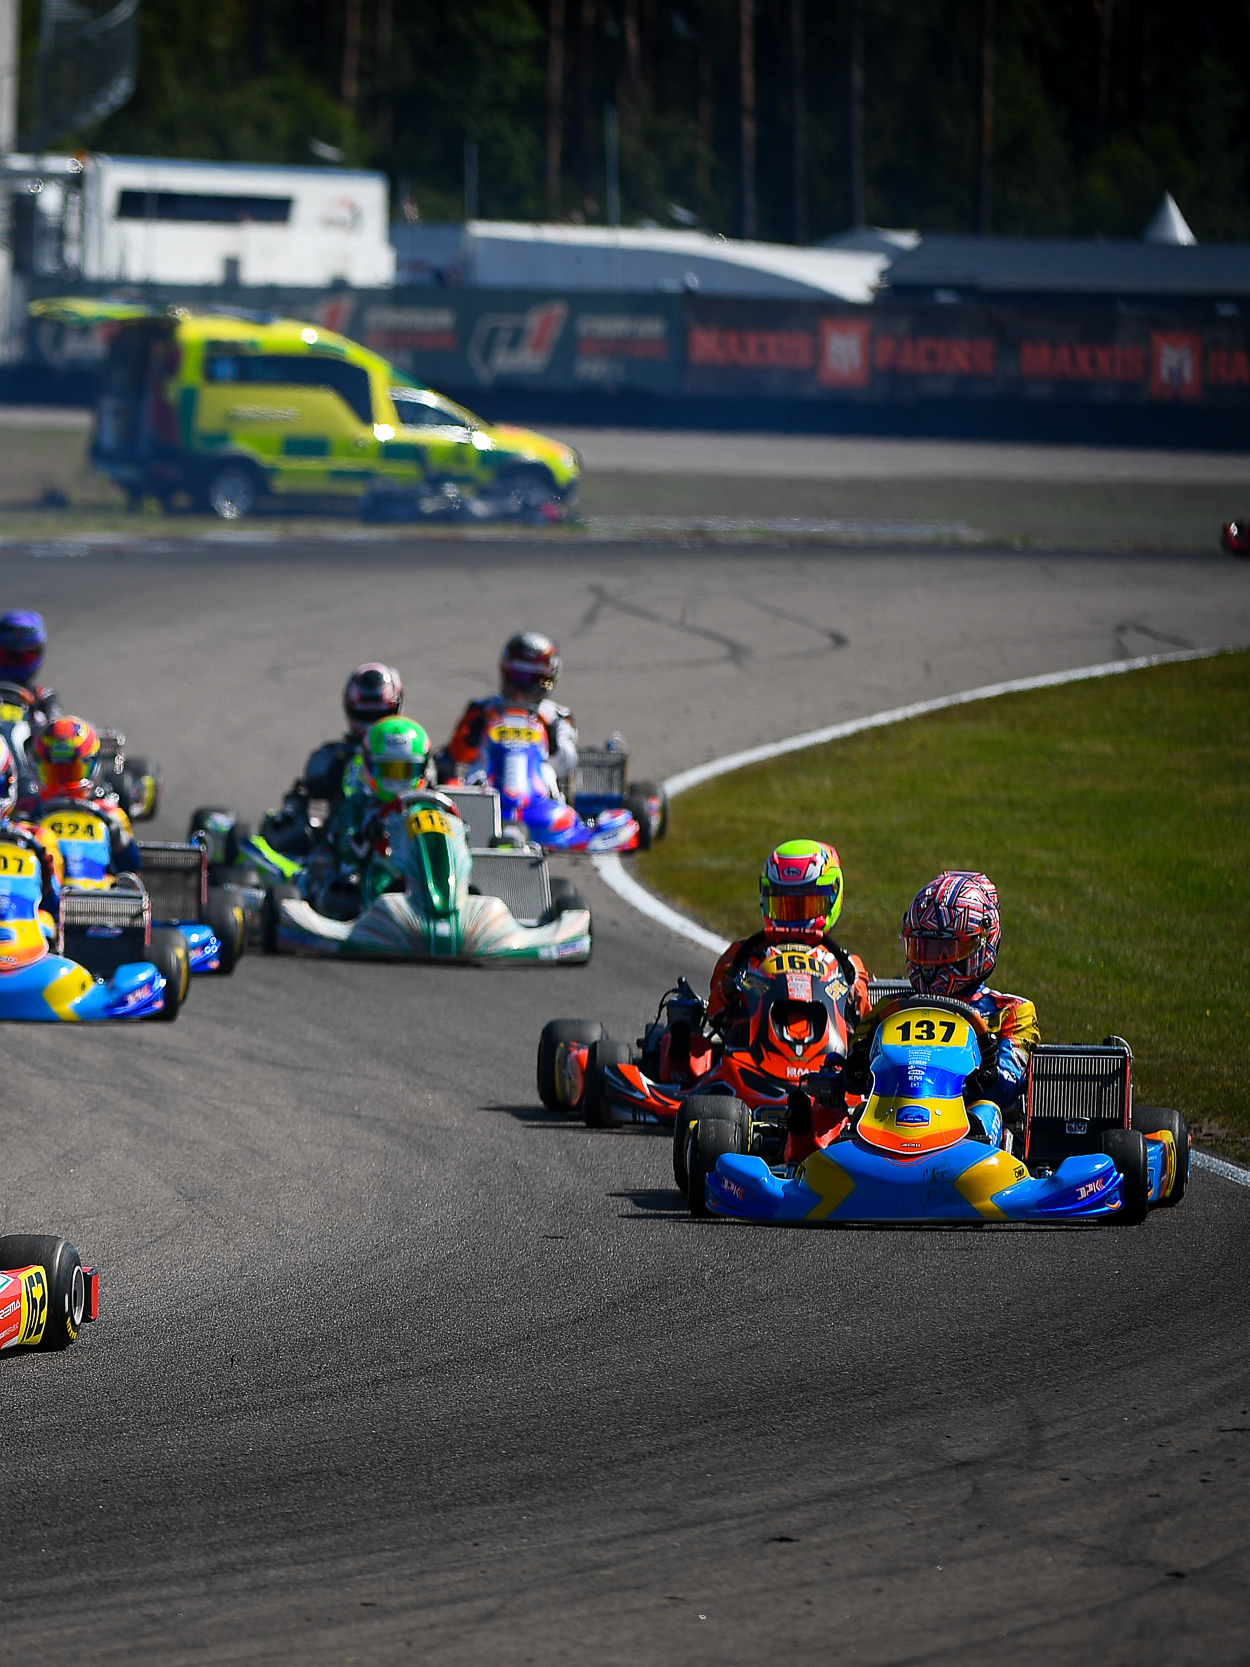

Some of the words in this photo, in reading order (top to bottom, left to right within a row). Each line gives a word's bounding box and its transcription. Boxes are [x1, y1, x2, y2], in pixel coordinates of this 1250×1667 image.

[1021, 340, 1146, 382] MAXXIS
[51, 821, 96, 838] 624
[768, 956, 826, 976] 160
[895, 1020, 957, 1043] 137
[24, 1271, 46, 1344] 162
